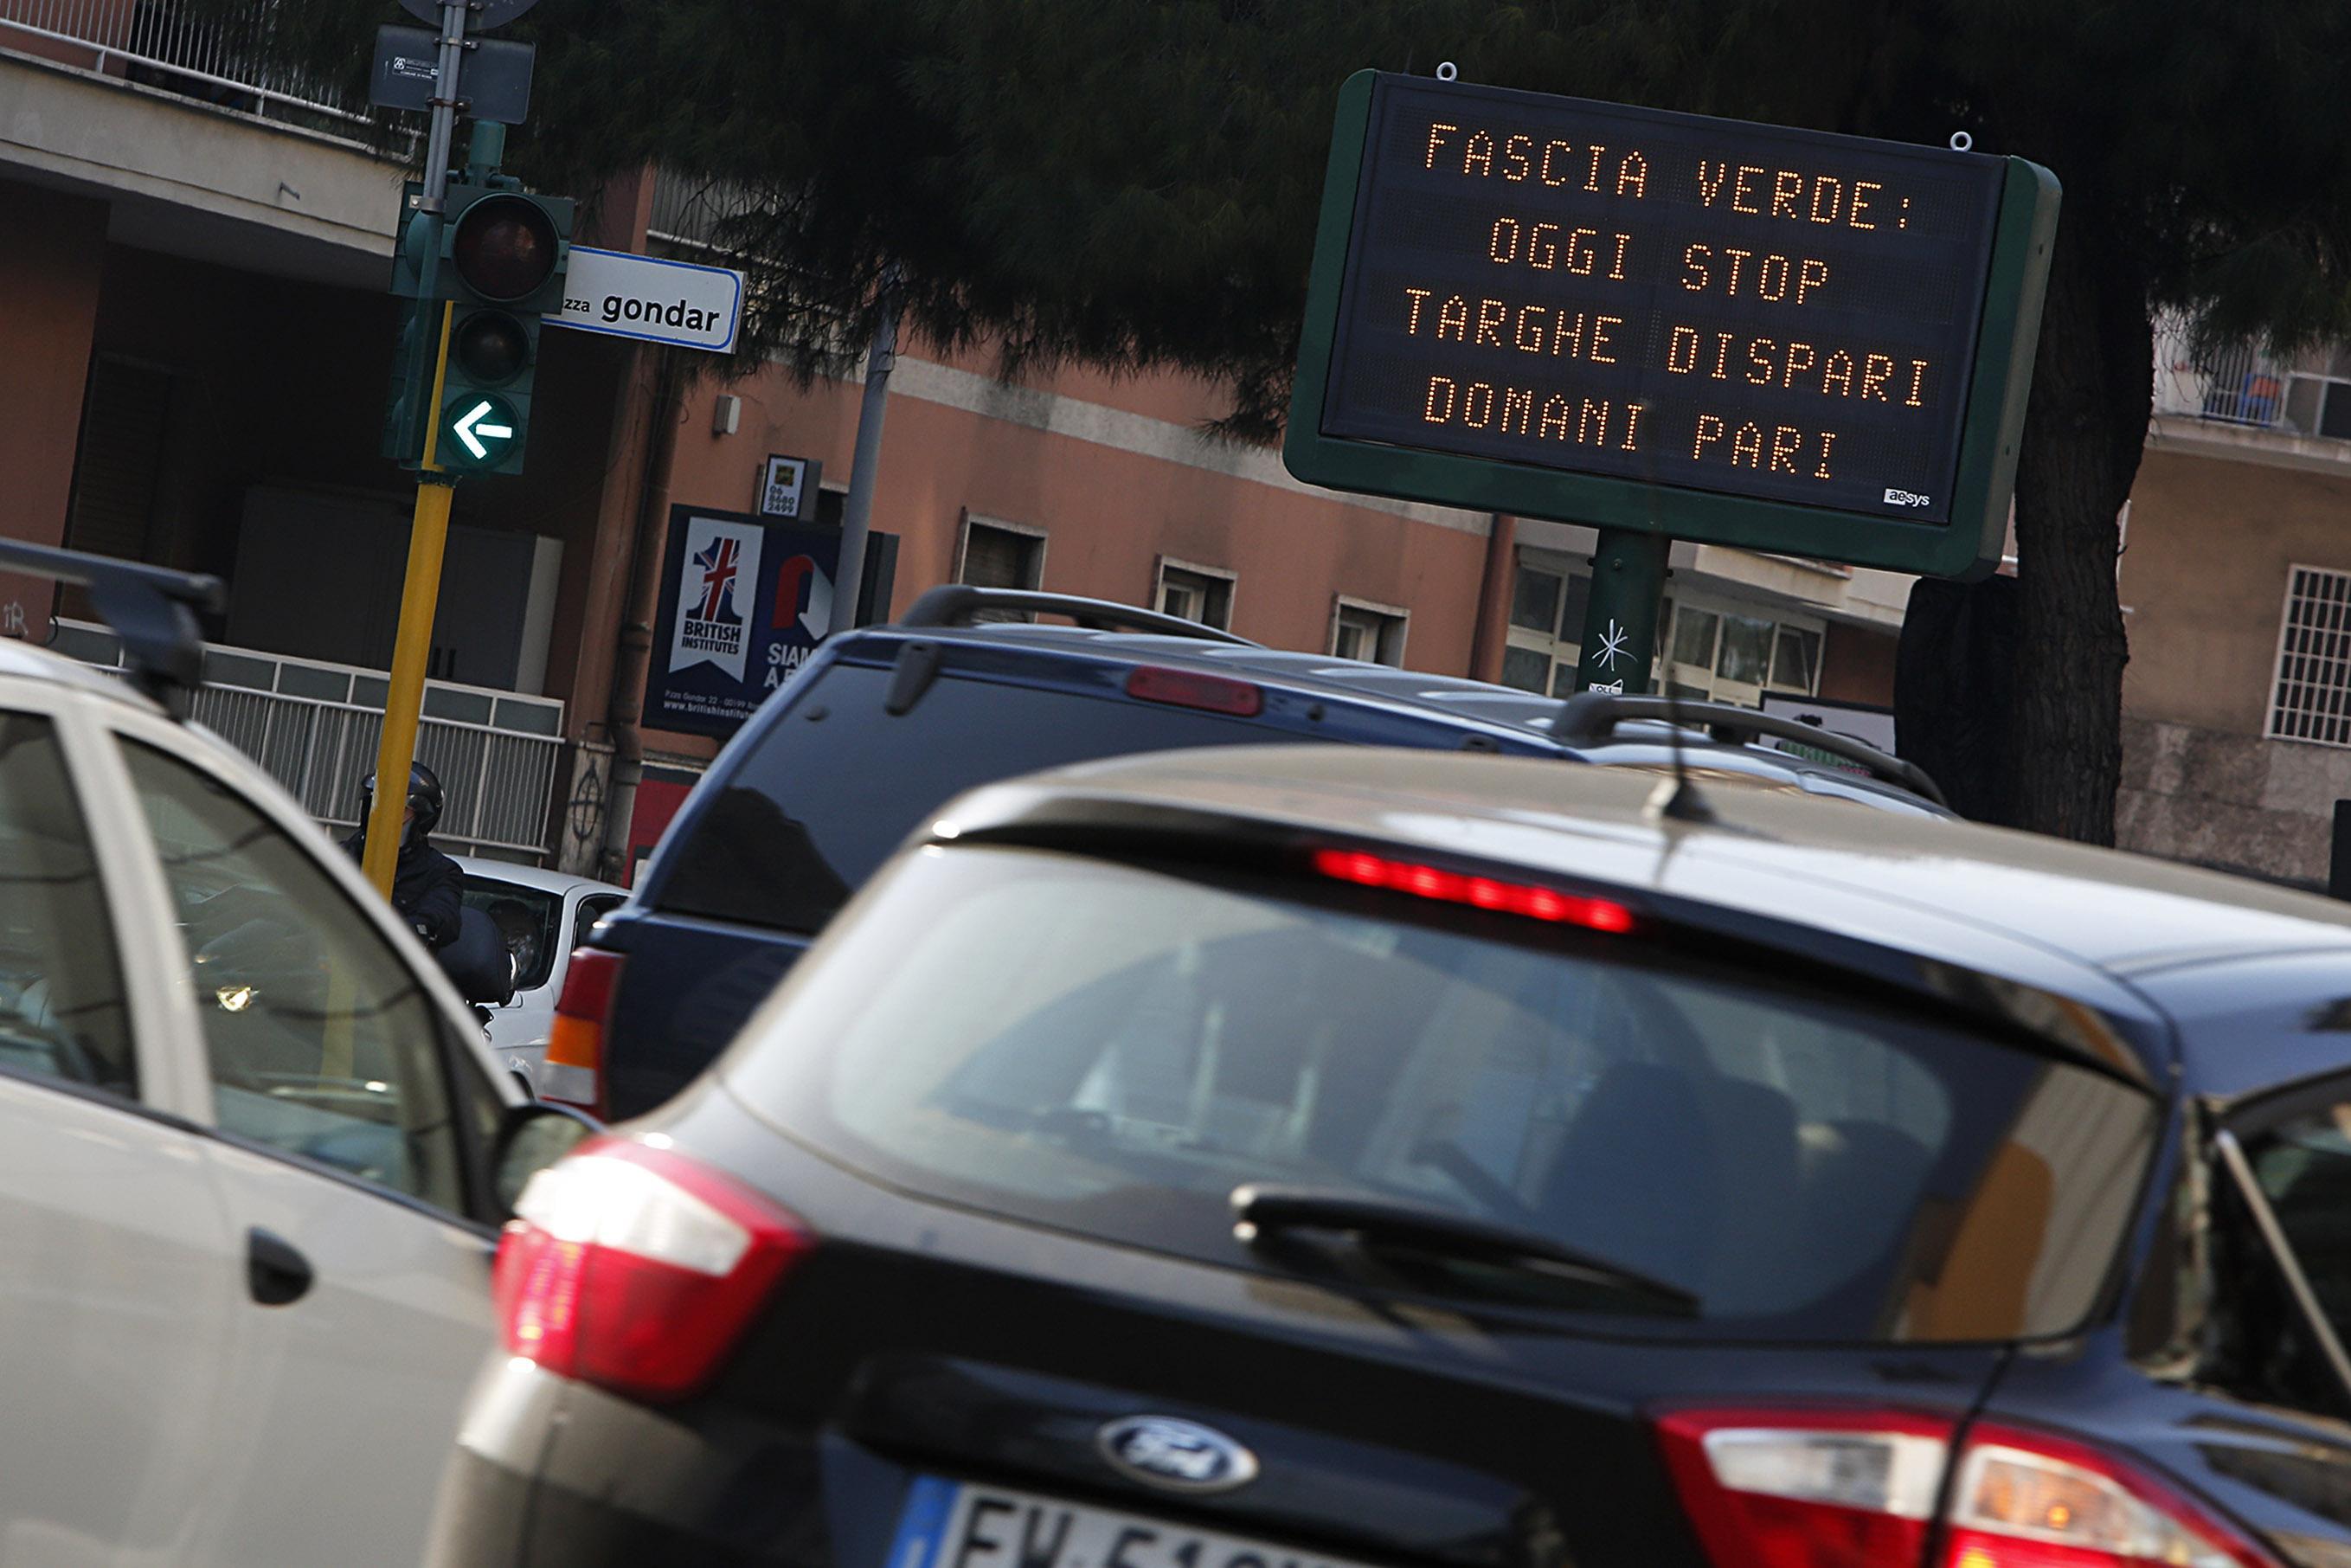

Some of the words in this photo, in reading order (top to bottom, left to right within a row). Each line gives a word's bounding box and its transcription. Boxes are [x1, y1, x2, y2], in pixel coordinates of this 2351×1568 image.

[1426, 123, 1648, 198] FASCIA
[1698, 161, 1910, 230] VERDE:
[1490, 217, 1630, 280] OGGI
[1682, 243, 1828, 305] STOP
[563, 298, 590, 312] zza
[601, 295, 720, 331] gondar
[1405, 288, 1622, 363] TARGHE
[1667, 325, 1928, 407] DISPARI
[1424, 376, 1645, 451] DOMANI
[1693, 414, 1836, 479] PARI
[1887, 489, 1930, 508] aesys
[682, 636, 740, 655] INSTITUTES
[684, 620, 742, 643] BRITISH
[767, 642, 818, 668] SIAM
